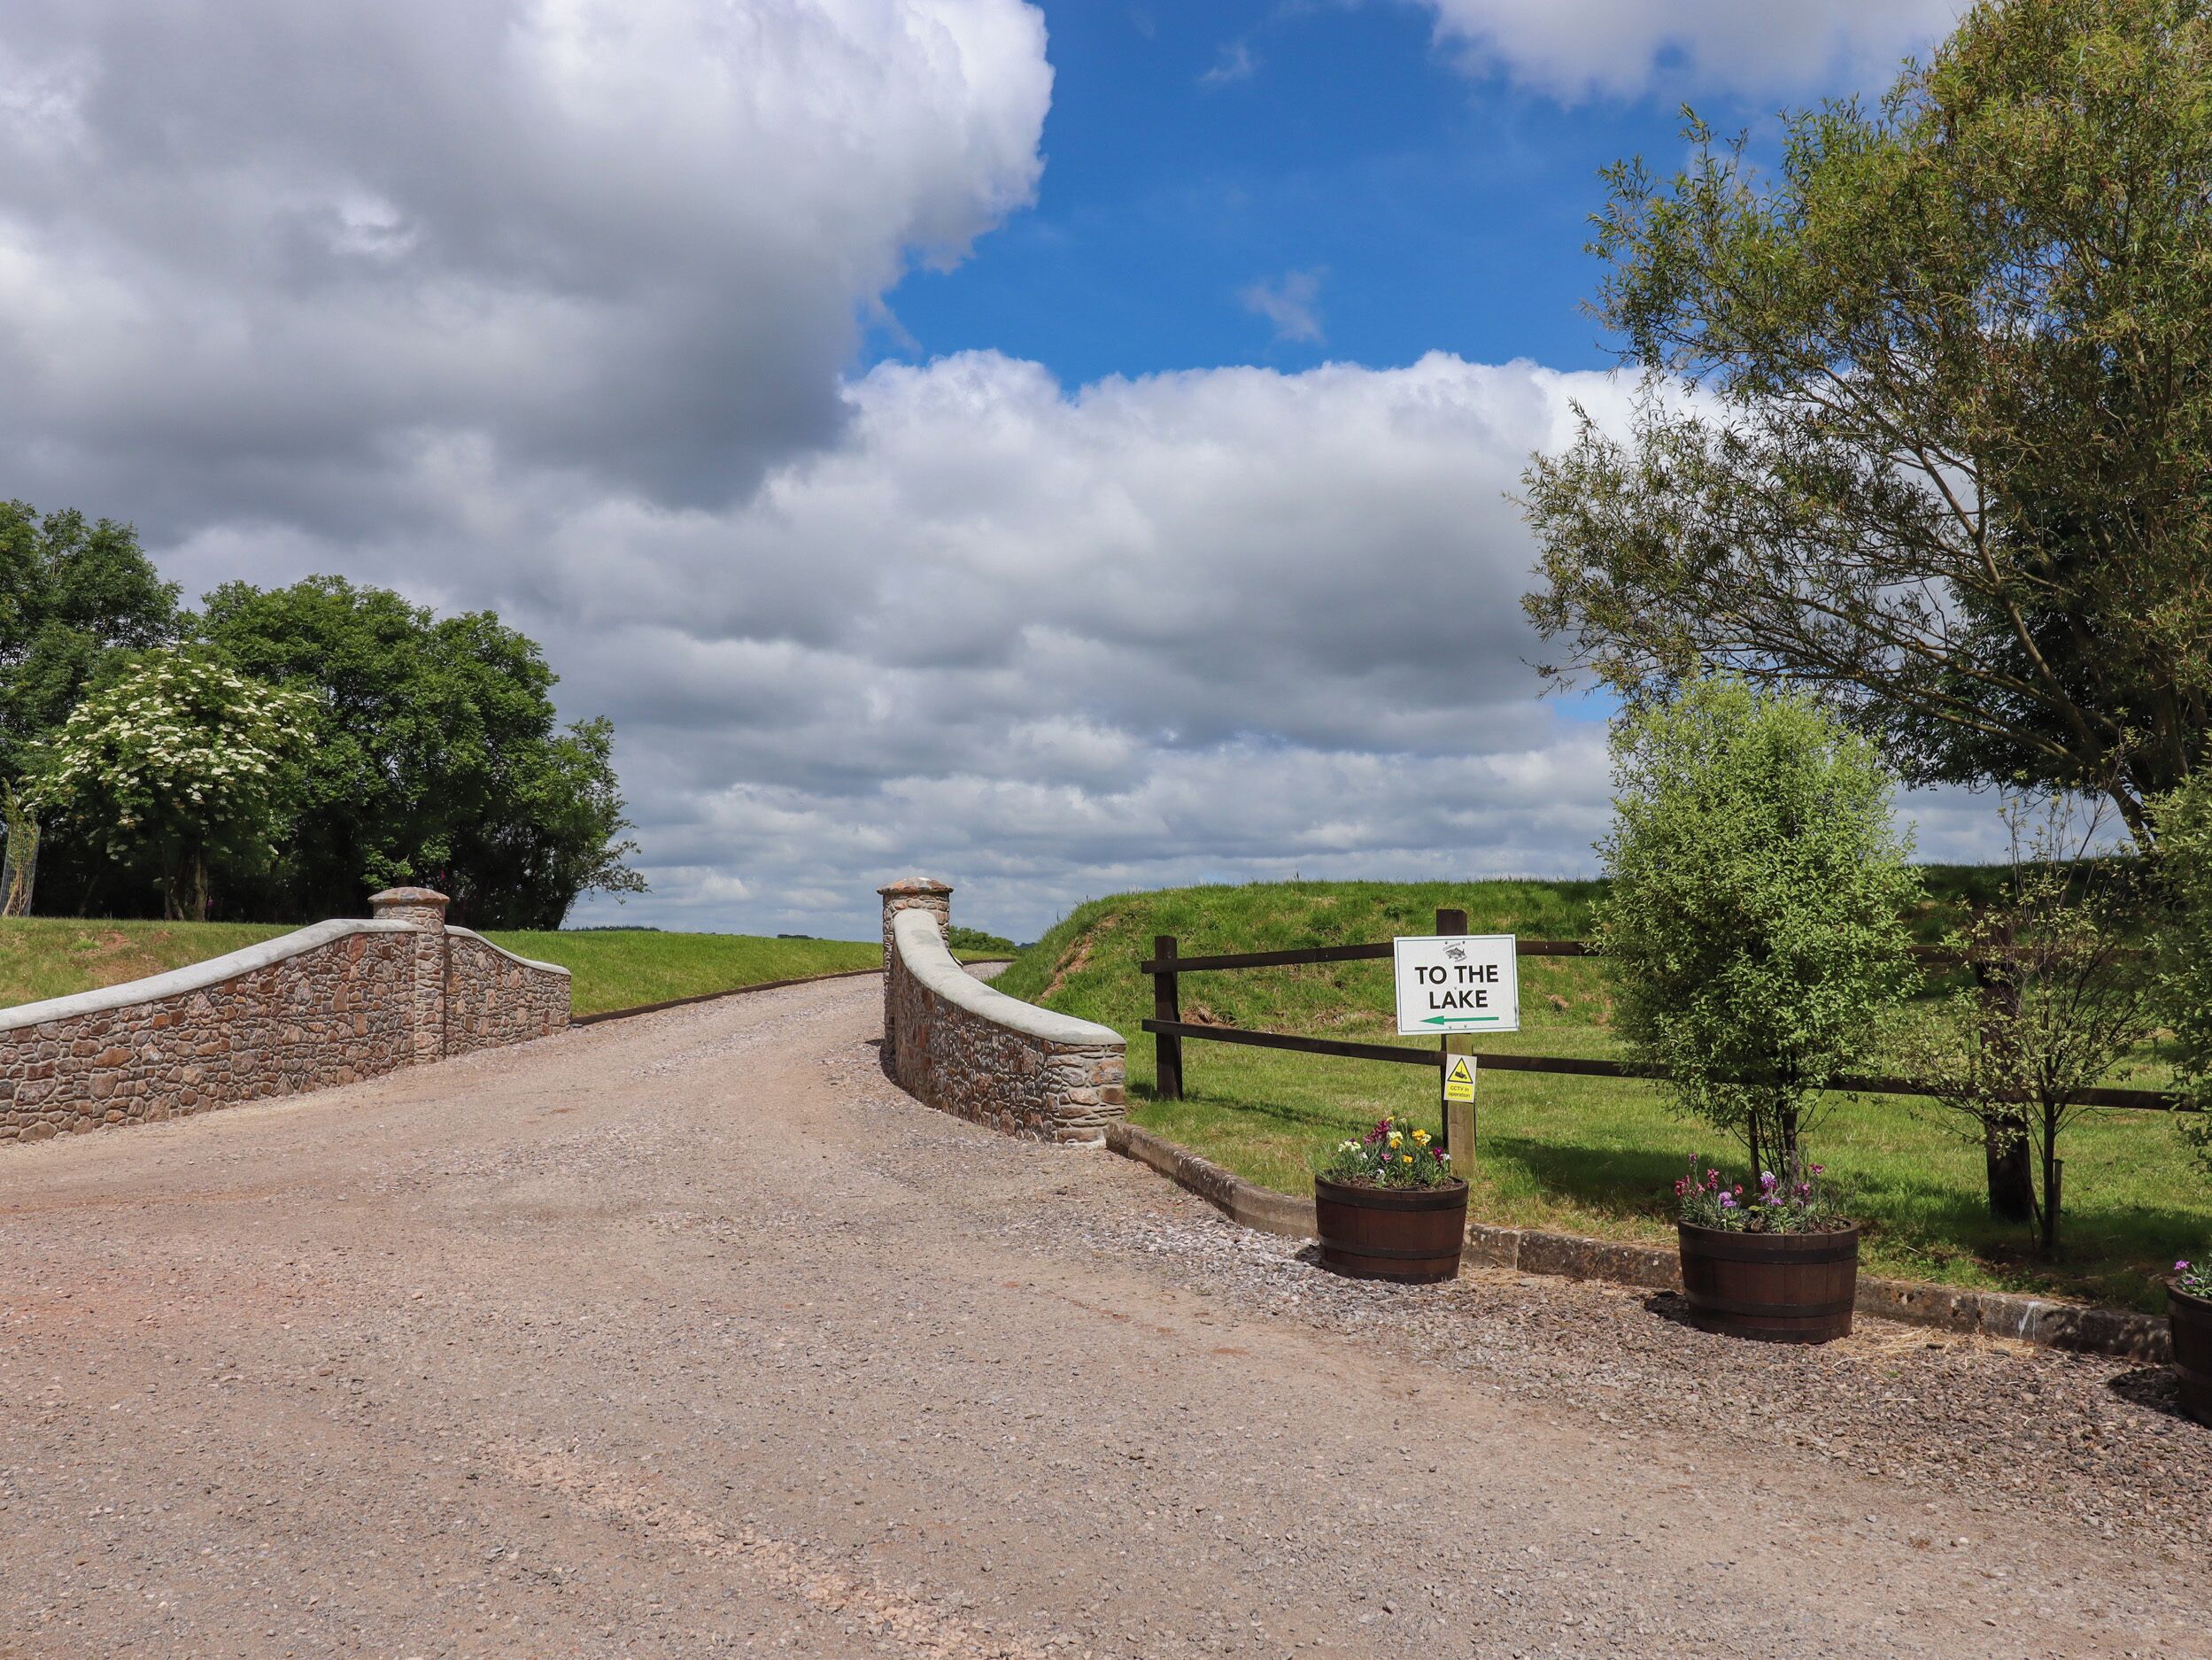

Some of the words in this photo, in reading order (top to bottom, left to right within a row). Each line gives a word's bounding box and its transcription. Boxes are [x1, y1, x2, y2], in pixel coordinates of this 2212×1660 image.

[1414, 966, 1447, 984] TO
[1454, 964, 1498, 984] THE
[1429, 990, 1489, 1009] LAKE
